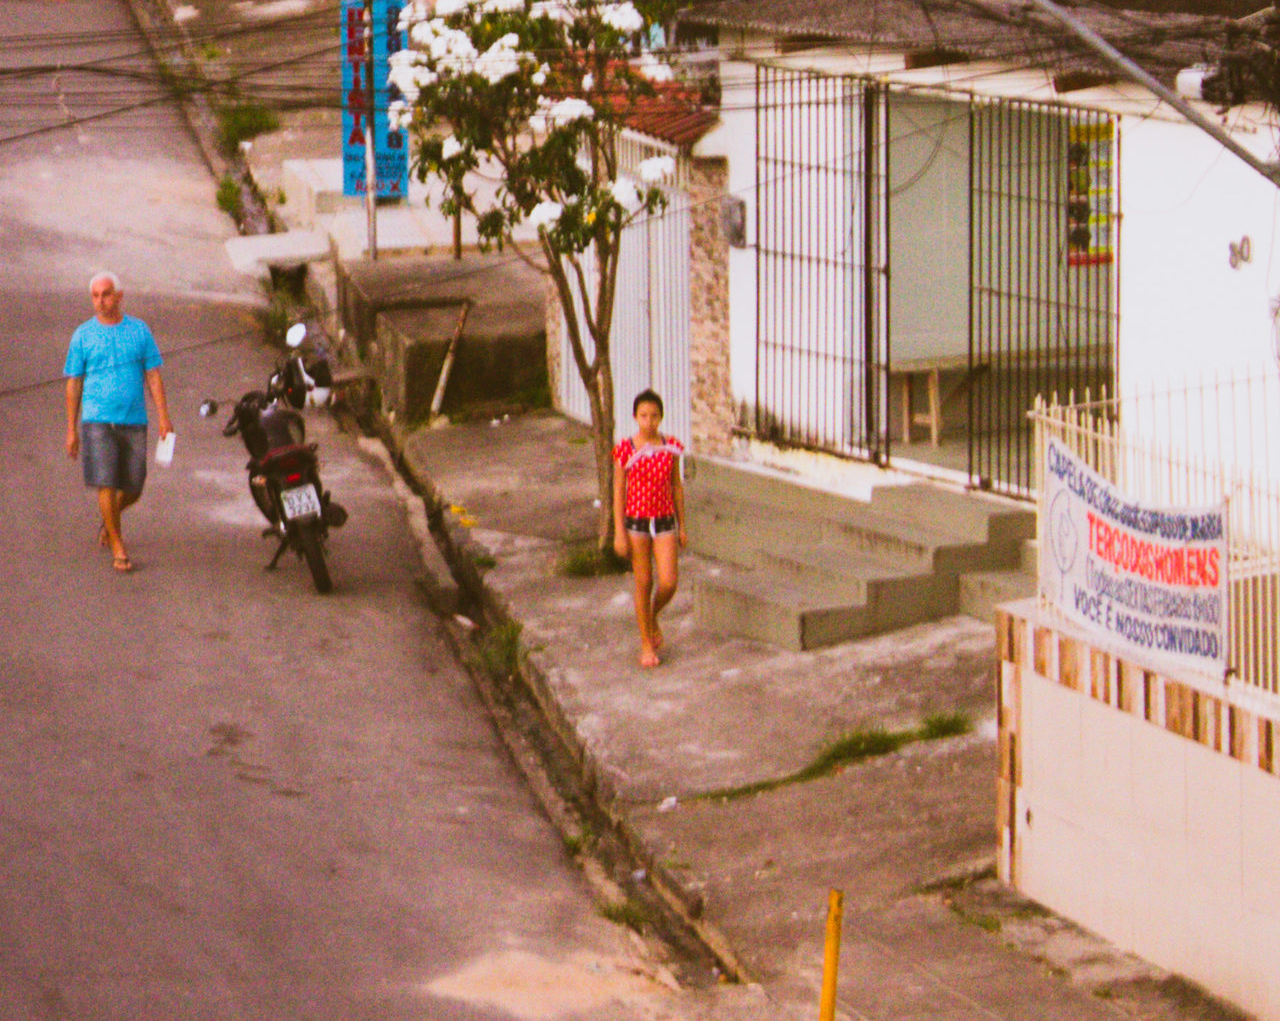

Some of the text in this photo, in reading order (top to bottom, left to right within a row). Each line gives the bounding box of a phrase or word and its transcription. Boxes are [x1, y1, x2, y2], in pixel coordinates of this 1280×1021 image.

[1087, 512, 1220, 587] TERÇO DOS HOMENS
